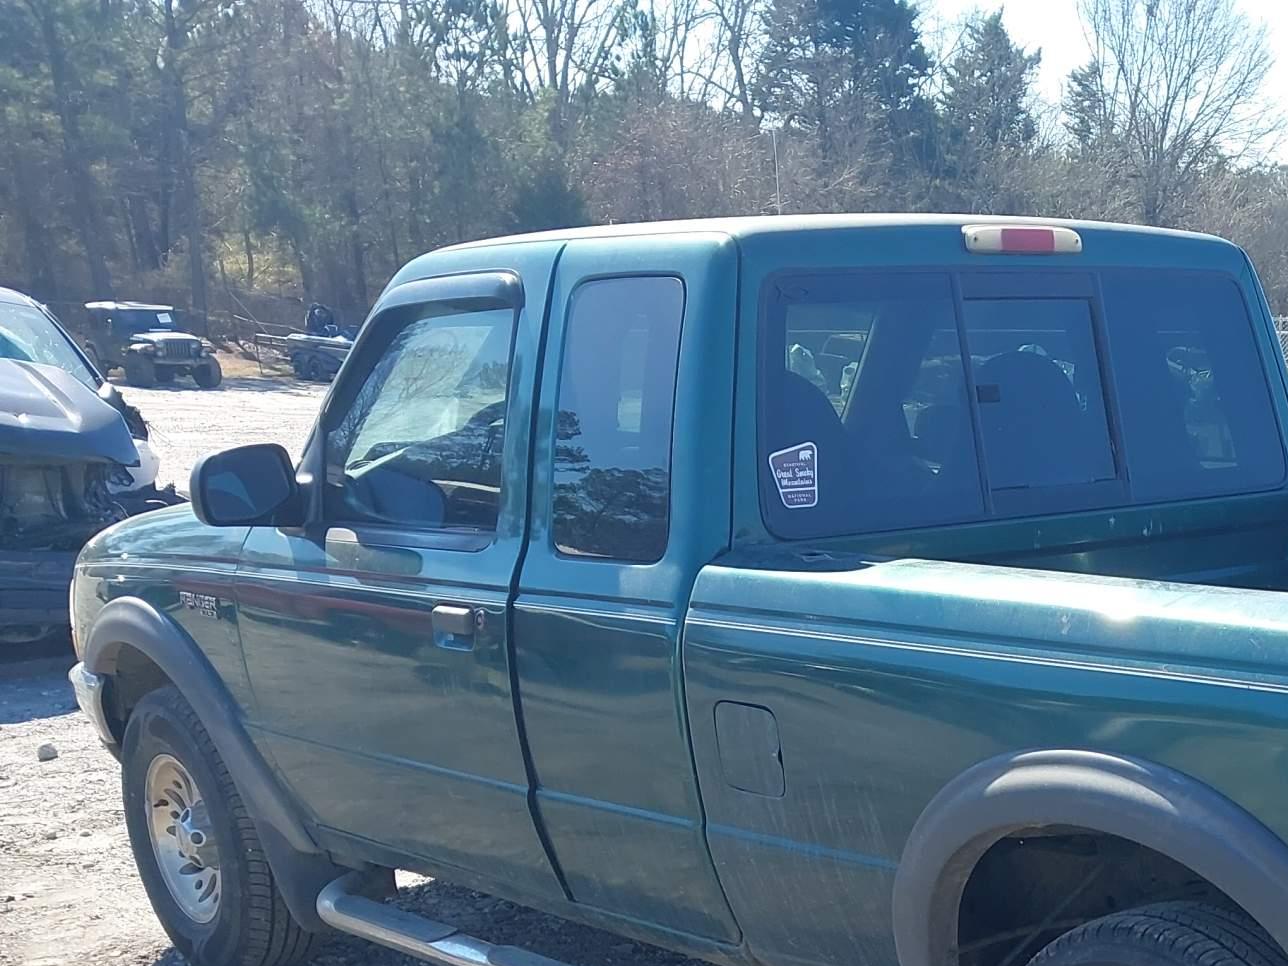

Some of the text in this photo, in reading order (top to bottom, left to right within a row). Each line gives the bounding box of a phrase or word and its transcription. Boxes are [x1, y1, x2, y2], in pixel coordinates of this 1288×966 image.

[776, 467, 814, 479] Great Smoky
[781, 478, 813, 487] Mountains
[179, 591, 217, 611] RANGER
